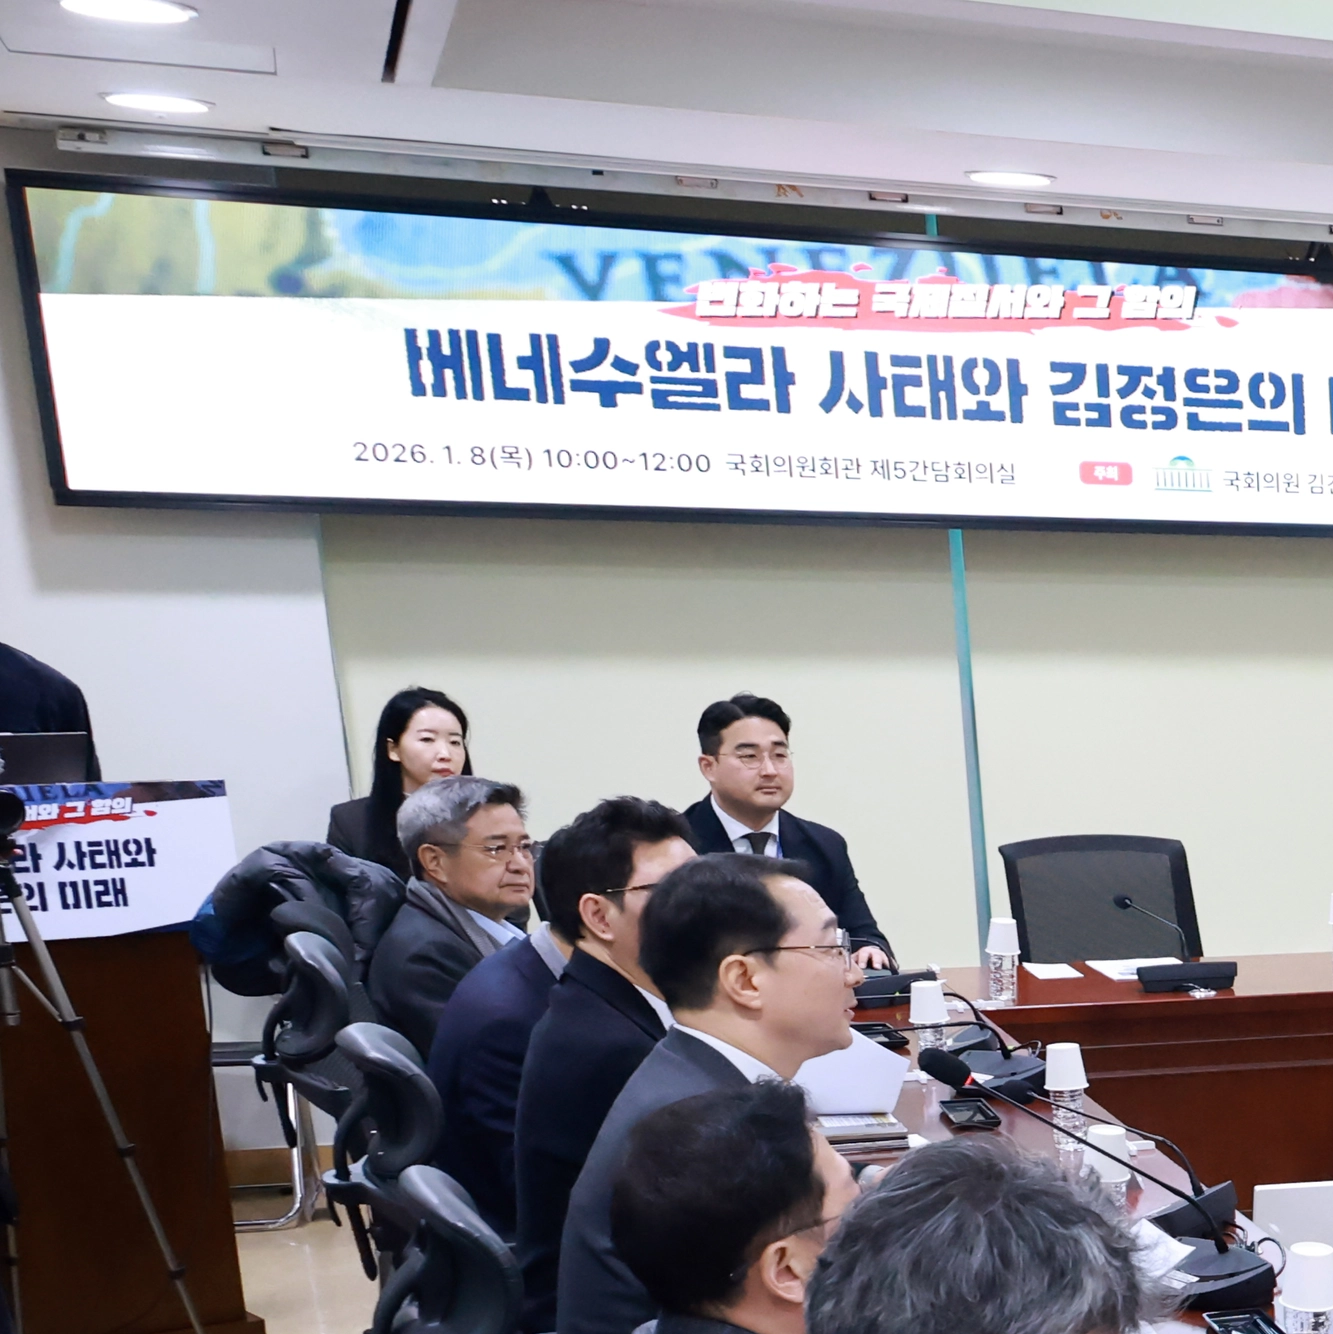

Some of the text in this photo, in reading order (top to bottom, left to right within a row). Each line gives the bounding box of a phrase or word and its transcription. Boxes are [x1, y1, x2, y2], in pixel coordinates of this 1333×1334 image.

[695, 280, 1198, 320] 변화하는 국제질서와 그 함의
[404, 327, 796, 417] 베네수엘라
[819, 348, 1028, 425] 사태와
[1049, 360, 1306, 435] 김정은의
[542, 448, 712, 473] 10:00~12:00
[725, 453, 862, 481] 국회의원회관
[870, 457, 1016, 485] 제5간담회의실
[1223, 470, 1300, 494] 국회의원
[63, 800, 86, 818] 그
[53, 837, 157, 871] 사태와
[58, 877, 129, 910] 미래
